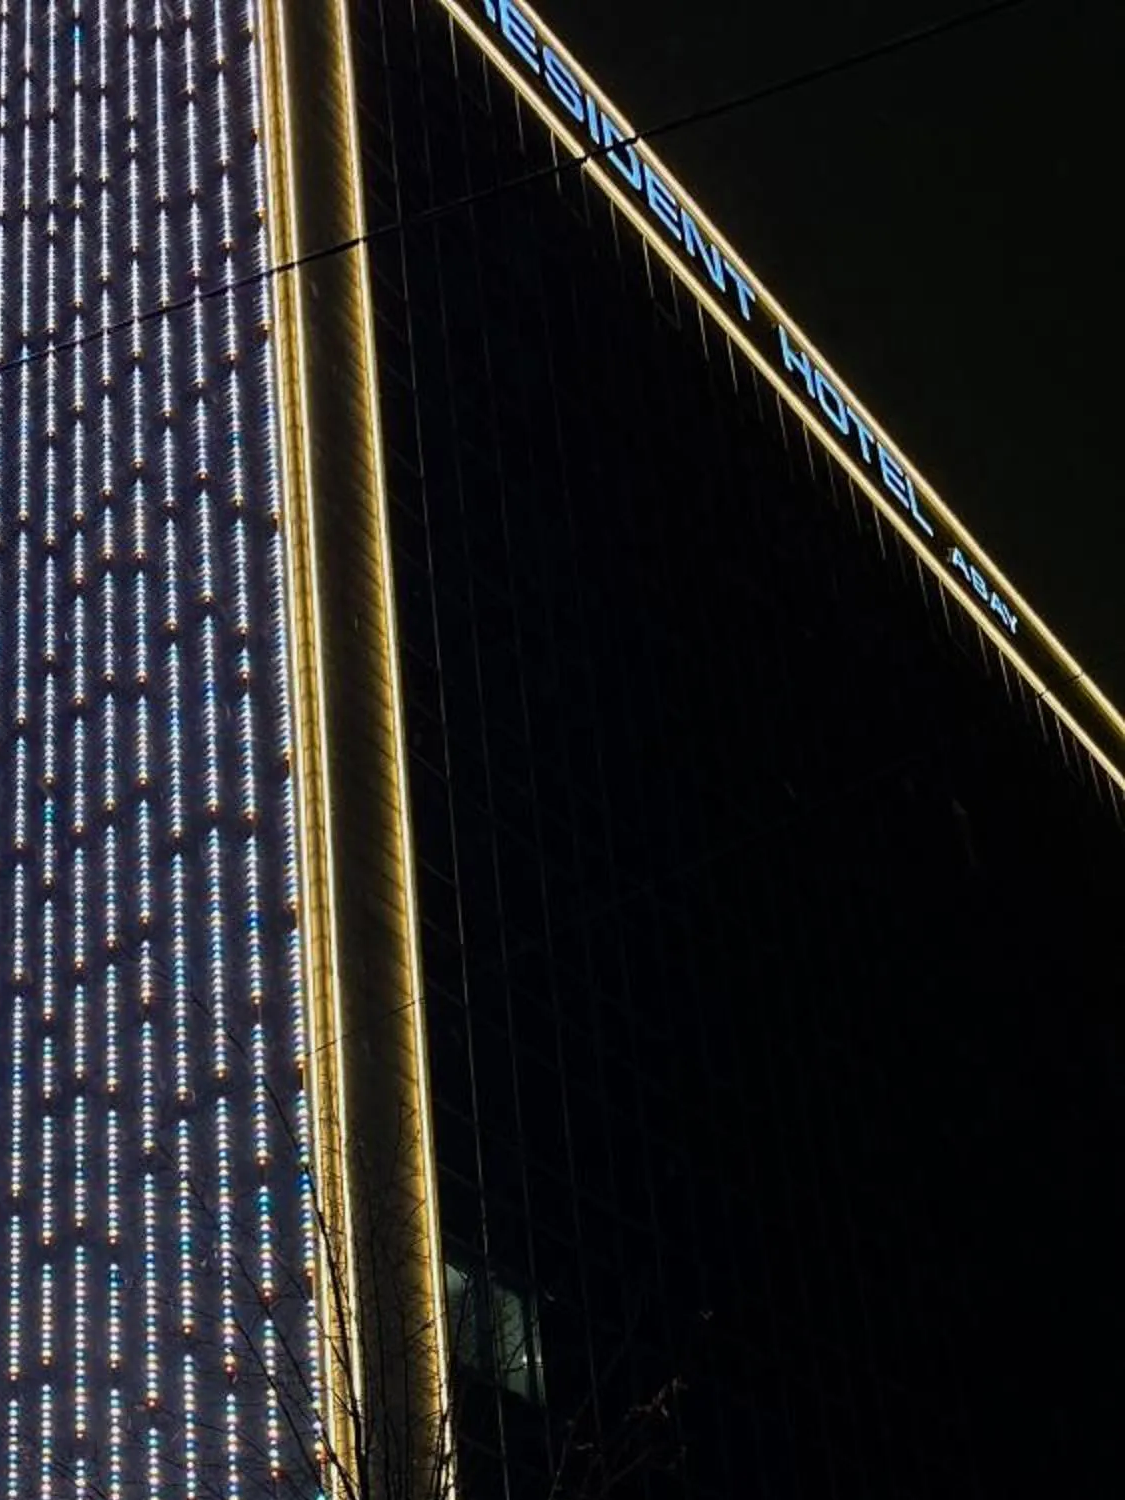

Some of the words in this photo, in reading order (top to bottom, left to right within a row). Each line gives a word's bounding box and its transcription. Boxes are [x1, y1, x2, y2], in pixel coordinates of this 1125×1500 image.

[483, 0, 756, 321] ESIDENT
[778, 323, 934, 537] HOTEL
[952, 546, 1018, 634] ABAY
